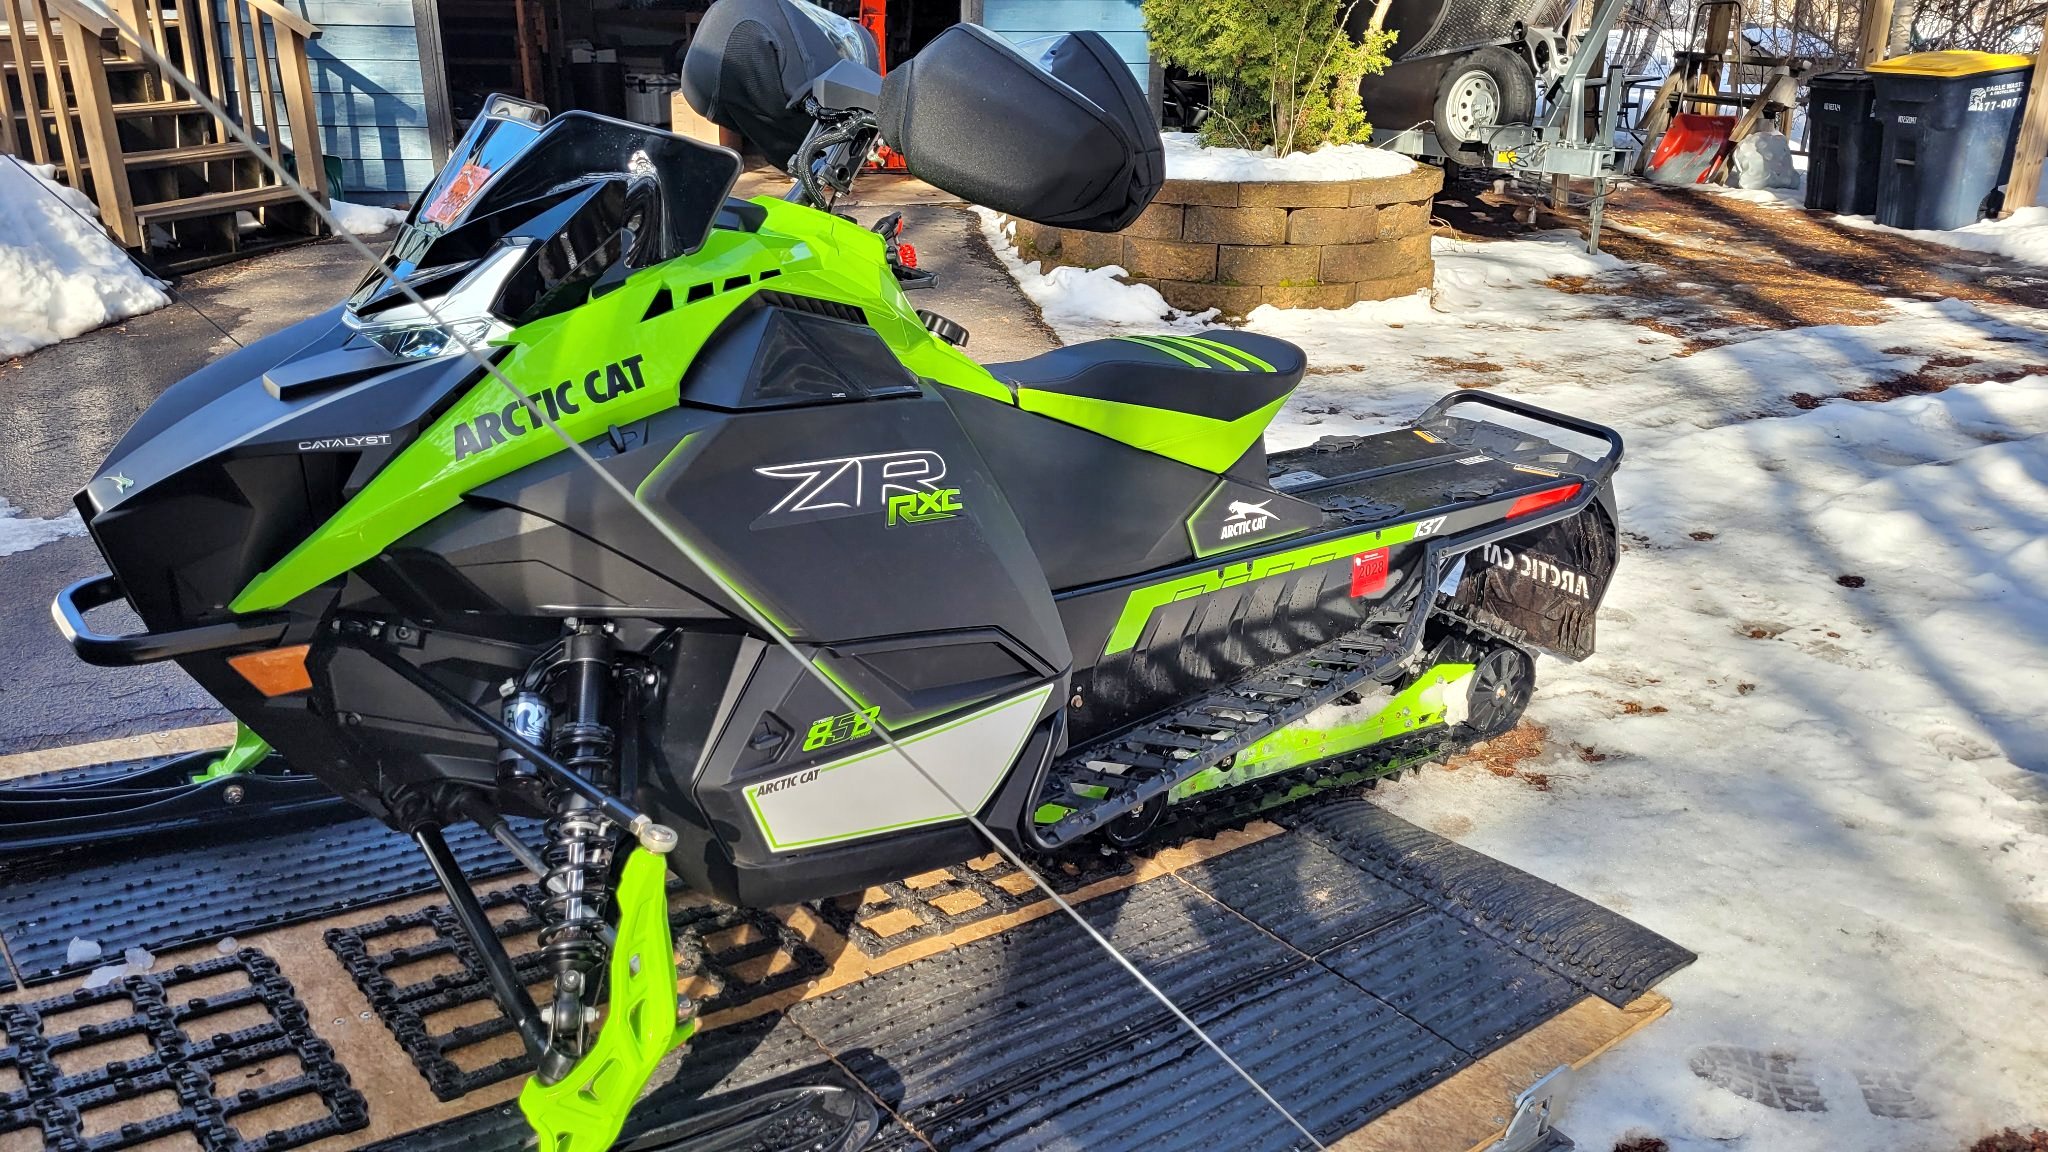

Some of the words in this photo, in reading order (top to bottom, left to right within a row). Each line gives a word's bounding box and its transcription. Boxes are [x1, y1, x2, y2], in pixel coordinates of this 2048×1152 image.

[453, 380, 580, 462] ARCTIC
[584, 354, 646, 405] CAT
[298, 434, 392, 450] CATALYST
[754, 450, 954, 515] ZR
[887, 488, 964, 527] RXC
[1221, 520, 1251, 540] ARCTIC
[1252, 516, 1268, 531] CAT
[1413, 516, 1448, 538] 137
[1359, 561, 1385, 579] 2028
[803, 706, 880, 751] 858
[756, 775, 798, 798] ARCTIC
[800, 768, 821, 785] CAT
